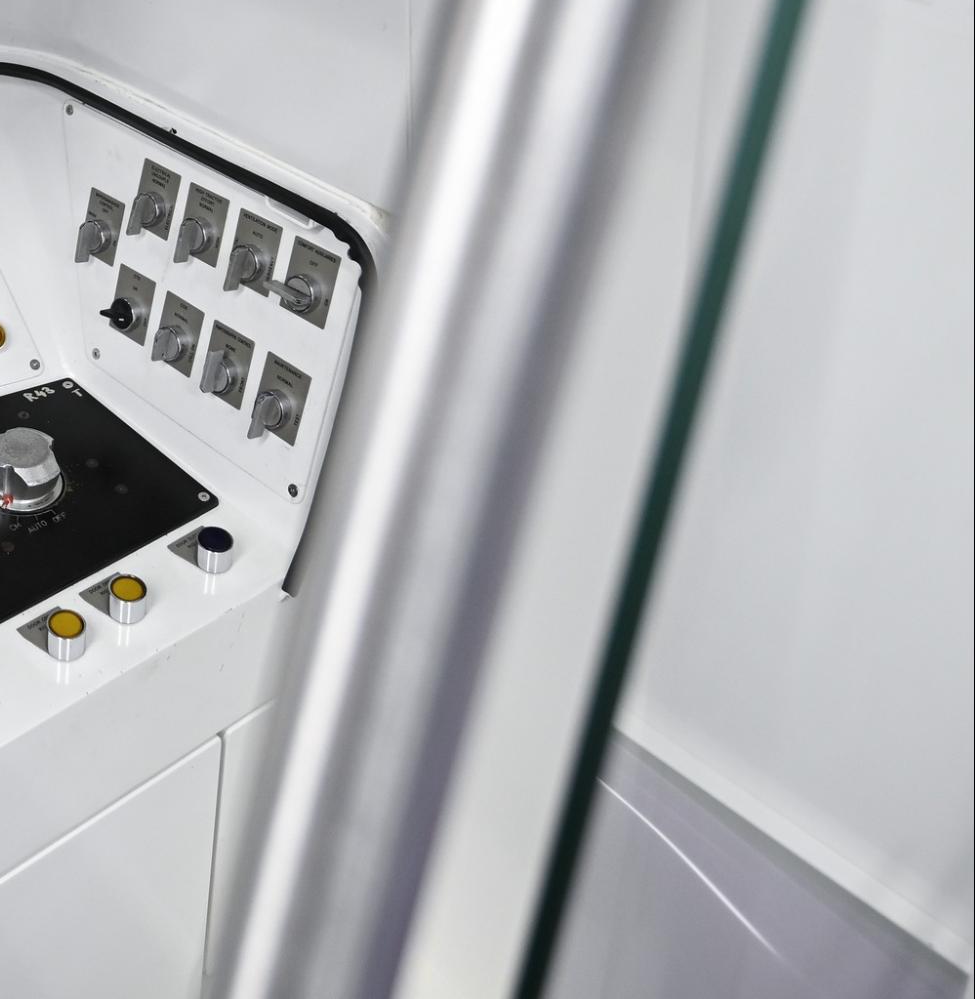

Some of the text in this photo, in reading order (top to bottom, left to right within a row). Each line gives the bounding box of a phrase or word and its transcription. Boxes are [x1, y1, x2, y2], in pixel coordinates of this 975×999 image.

[243, 212, 278, 233] VENTILATION MODE
[252, 230, 263, 239] AUTO
[23, 386, 55, 402] R43
[52, 512, 67, 523] OFF
[27, 520, 48, 534] AUTO
